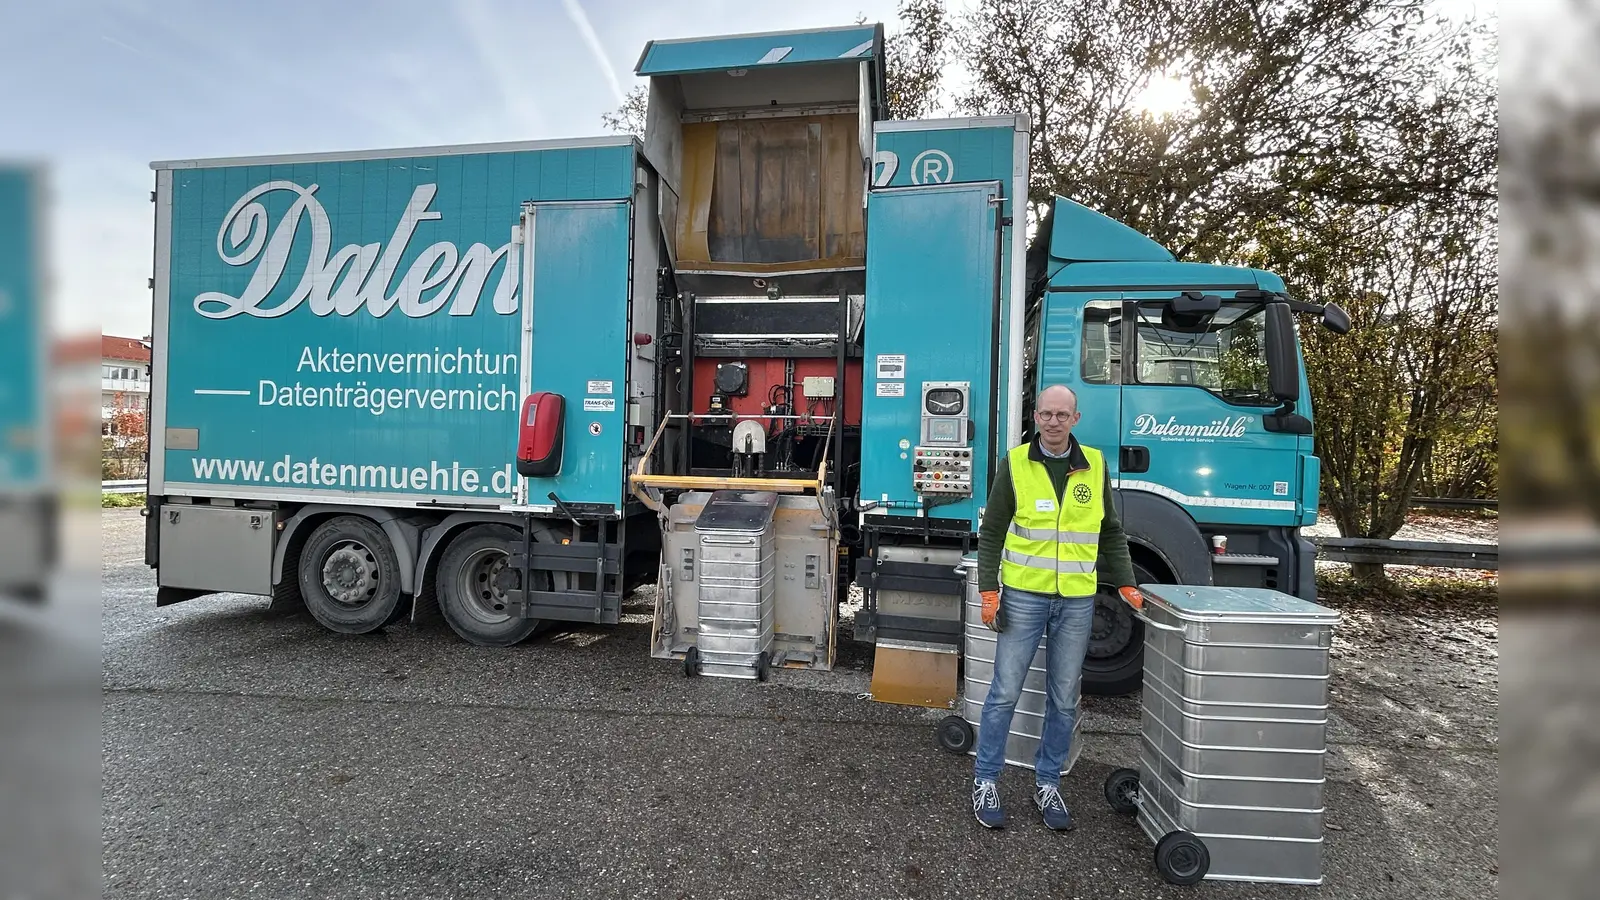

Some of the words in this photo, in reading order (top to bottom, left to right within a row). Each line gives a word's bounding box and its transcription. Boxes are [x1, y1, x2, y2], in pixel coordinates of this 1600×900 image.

[193, 180, 519, 318] Daten
[296, 346, 517, 374] Aktenvernichtun
[258, 379, 516, 416] Datenträgervernich
[1224, 482, 1247, 490] Wagen
